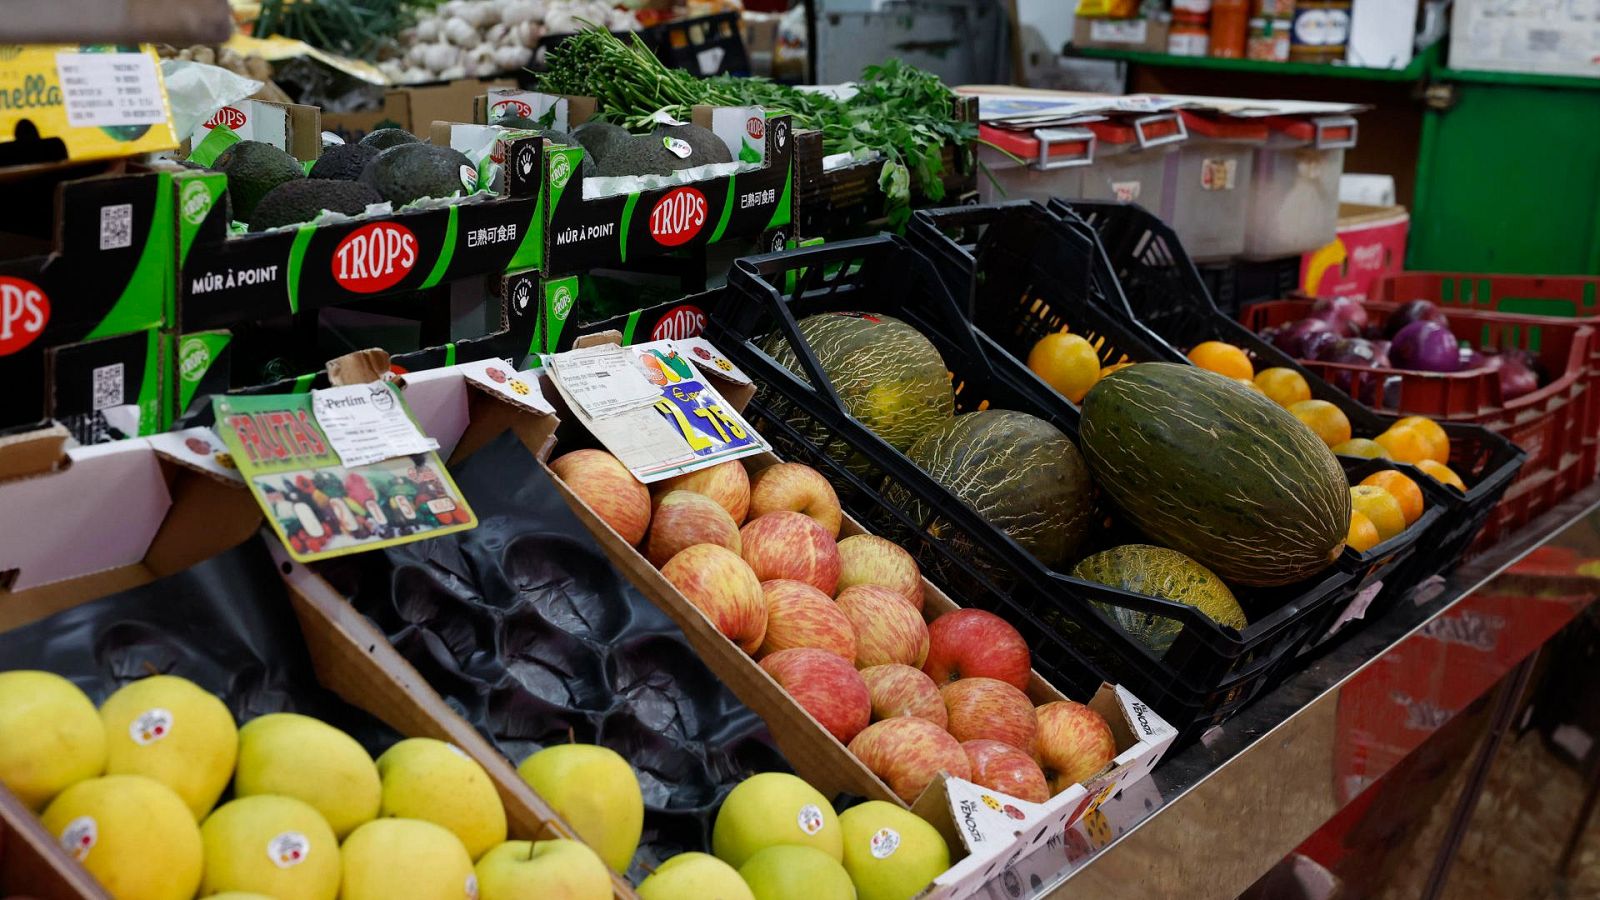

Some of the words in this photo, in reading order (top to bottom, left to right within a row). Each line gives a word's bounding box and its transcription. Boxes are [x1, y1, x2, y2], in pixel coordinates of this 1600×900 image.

[652, 191, 705, 235] TROPS
[741, 188, 775, 209] 已熟可食用
[467, 223, 517, 248] 已熟可食用
[556, 227, 578, 245] MÛR
[579, 225, 586, 242] À
[587, 222, 615, 240] POINT
[337, 227, 415, 280] TROPS
[191, 272, 224, 295] MÛR
[225, 269, 236, 289] À
[237, 265, 278, 287] POINT
[325, 395, 367, 409] Perlim
[229, 409, 329, 463] FRUTAS
[1131, 702, 1153, 735] VENOSTA
[960, 800, 982, 842] VENOSTA
